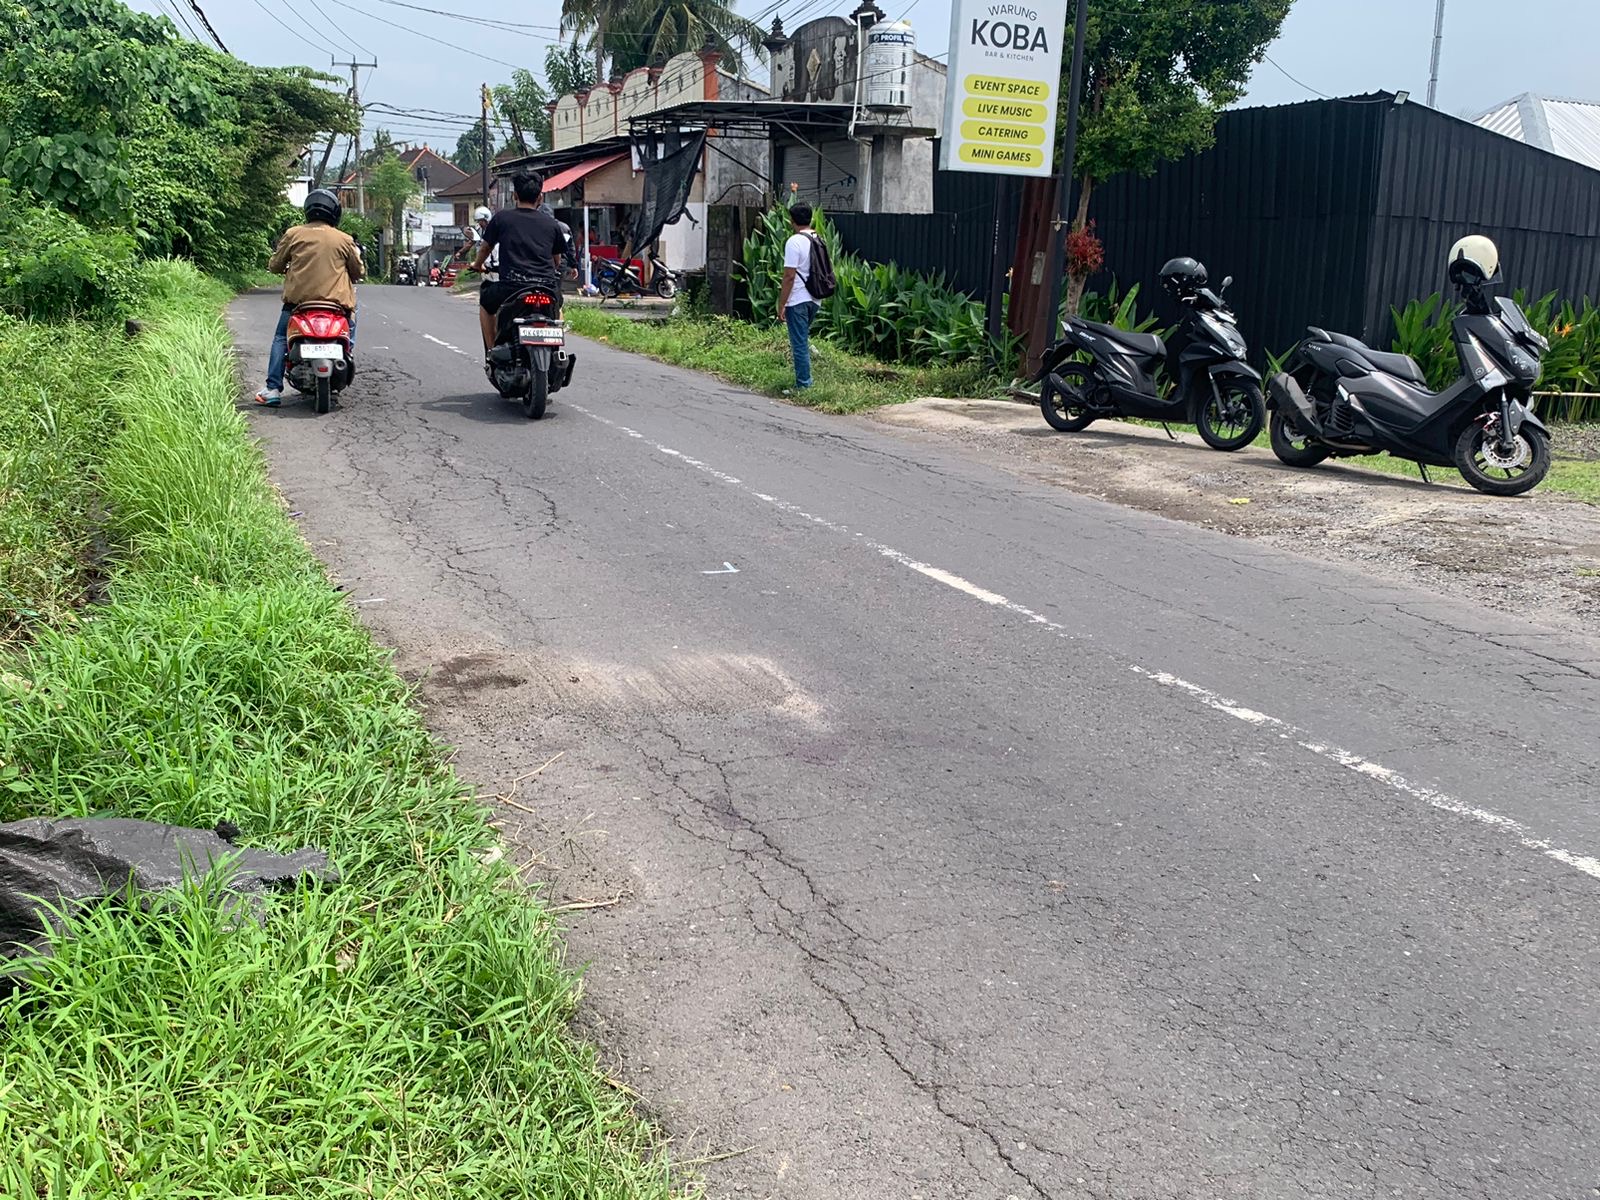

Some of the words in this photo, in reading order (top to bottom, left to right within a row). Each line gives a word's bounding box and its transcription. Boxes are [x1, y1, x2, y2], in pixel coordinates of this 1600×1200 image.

[988, 4, 1038, 21] WARUNG
[971, 18, 1049, 53] KOBA
[984, 50, 998, 58] BAR
[1006, 53, 1034, 62] KITCHEN
[973, 79, 1006, 92] EVENT
[1007, 83, 1040, 96] SPACE
[977, 103, 999, 114] LIVE
[1000, 105, 1033, 118] MUSIC
[978, 126, 1029, 139] CATERING
[971, 148, 995, 159] MINI
[996, 150, 1031, 162] GAMES
